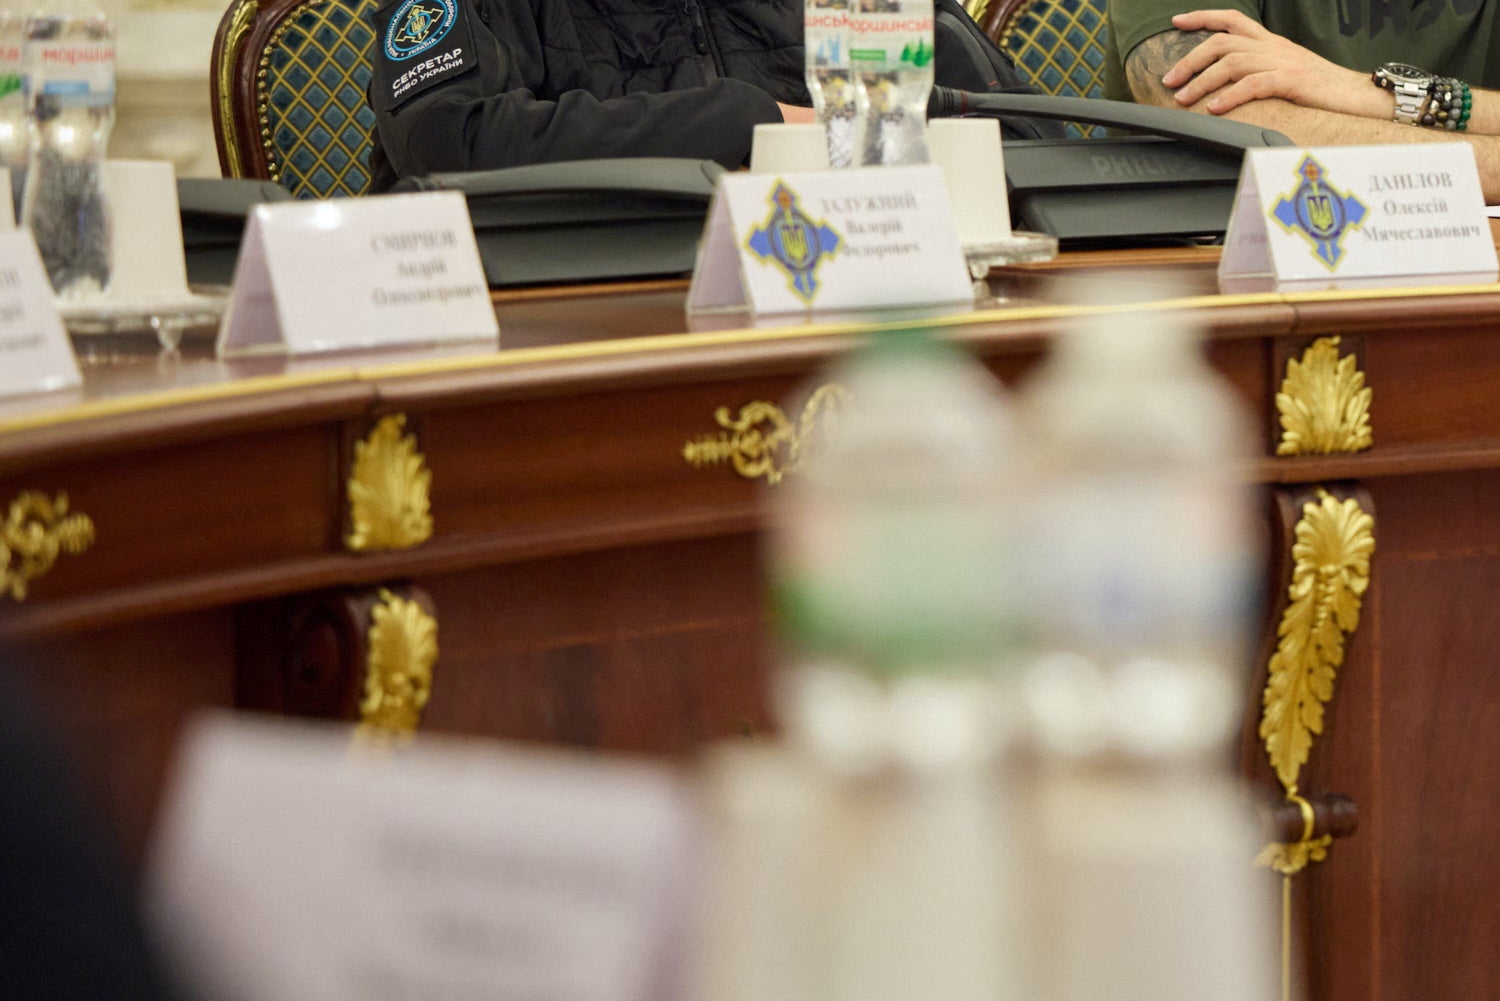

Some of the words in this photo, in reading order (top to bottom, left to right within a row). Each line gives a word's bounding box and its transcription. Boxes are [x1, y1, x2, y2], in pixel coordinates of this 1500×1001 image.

[392, 48, 463, 90] СЕКРЕТАР
[393, 79, 418, 99] РНБО
[419, 58, 464, 82] УКРАЇНИ
[1369, 172, 1453, 192] ДАНІЛОВ
[1383, 197, 1448, 216] Олексій
